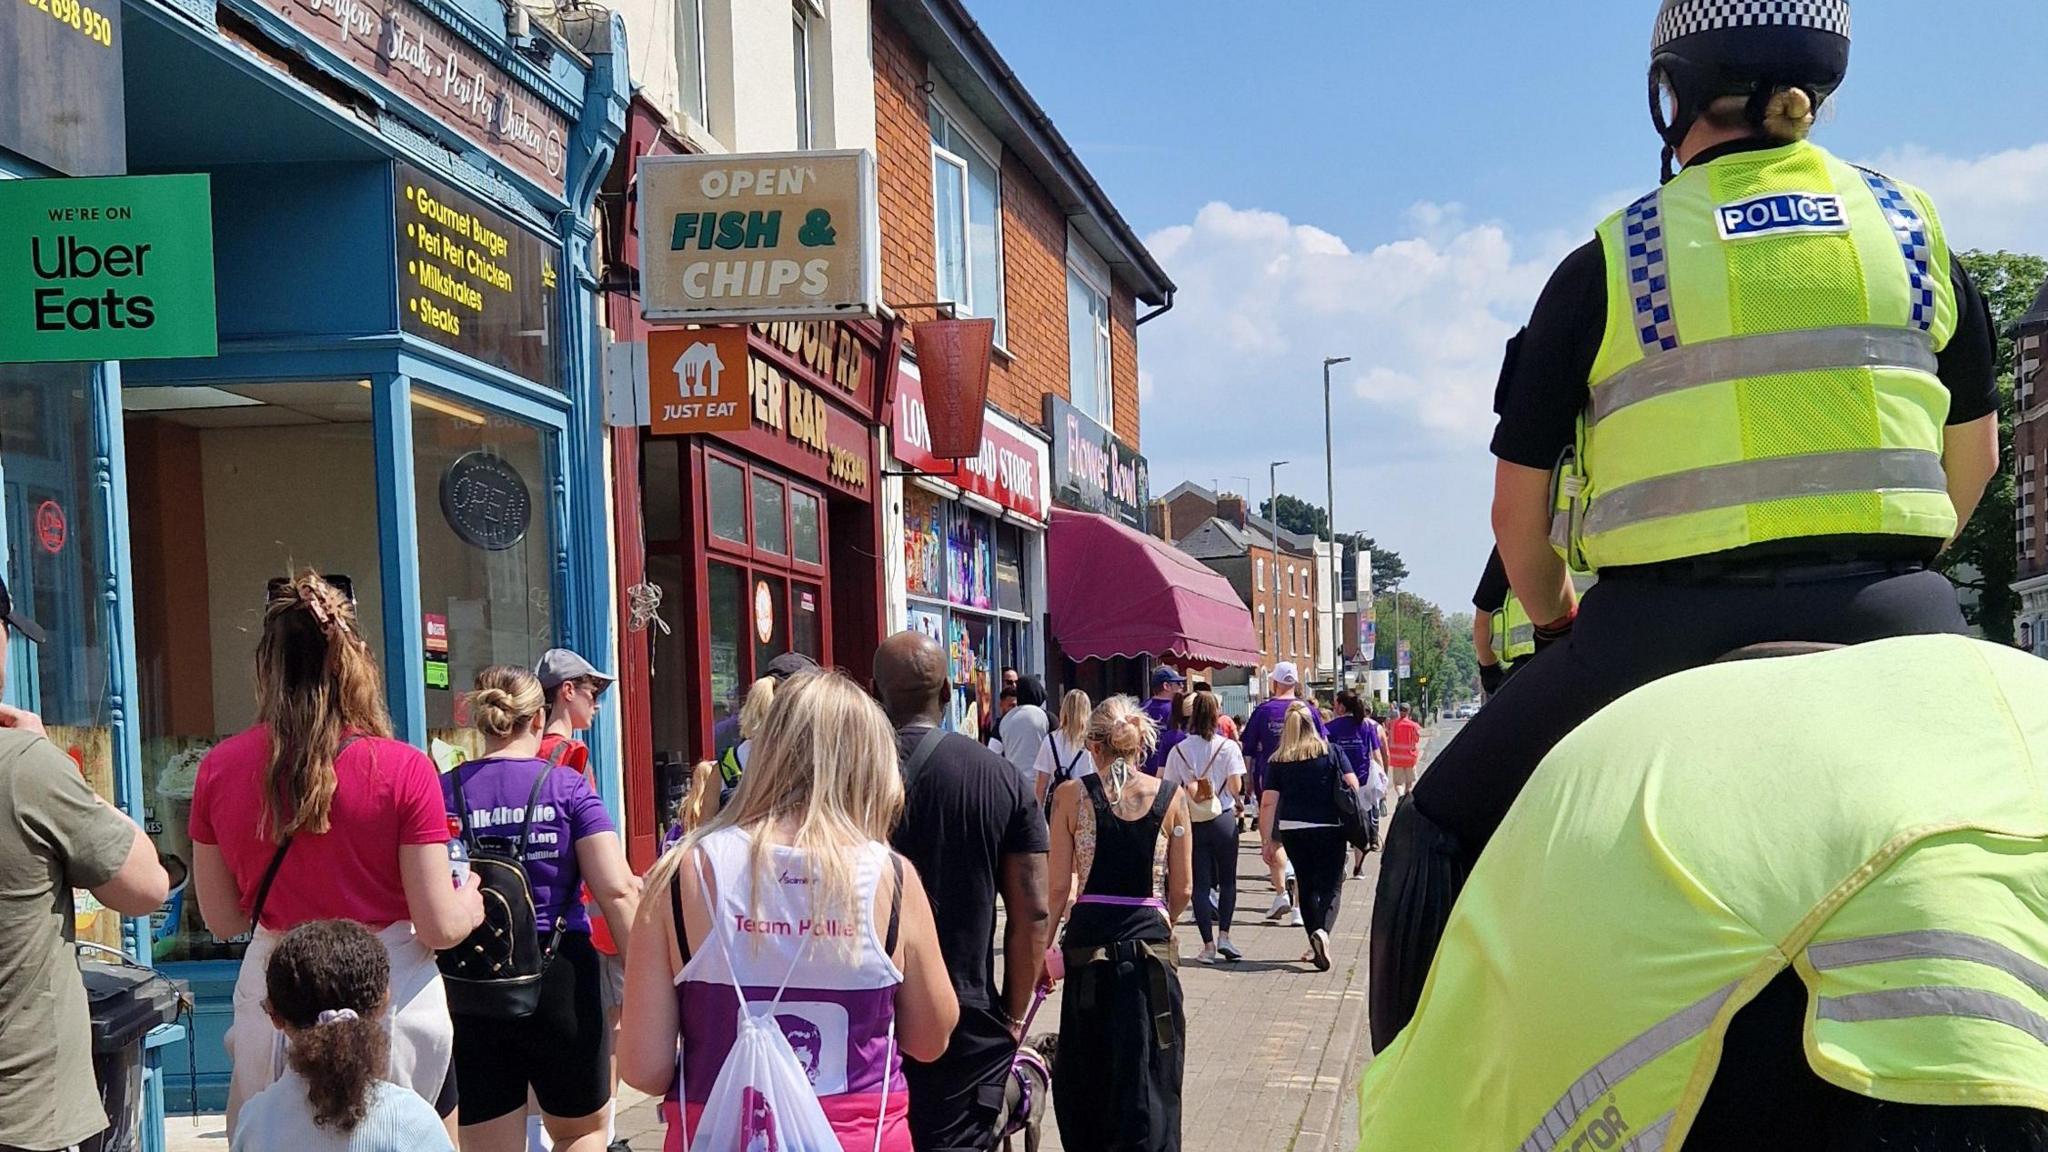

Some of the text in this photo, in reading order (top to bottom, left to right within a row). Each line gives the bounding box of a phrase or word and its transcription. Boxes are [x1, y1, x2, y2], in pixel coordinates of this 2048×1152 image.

[83, 7, 111, 47] 950
[311, 0, 374, 42] rgers
[387, 11, 433, 77] Steaks
[499, 93, 542, 154] Chicken
[701, 166, 805, 199] OPEN
[105, 206, 132, 220] ON
[417, 187, 508, 257] Gourmet Burger
[671, 208, 837, 250] FISH &
[1724, 197, 1841, 230] POLICE
[31, 235, 152, 280] Uber
[417, 223, 441, 257] Peri
[443, 235, 465, 269] Peri
[467, 250, 513, 292] Chicken
[682, 258, 830, 300] CHIPS
[419, 260, 482, 312] Milkshakes
[34, 287, 156, 331] Eats
[420, 296, 461, 336] Steaks
[836, 328, 863, 392] RD
[662, 401, 738, 421] JUST EAT
[788, 378, 828, 453] BAR
[902, 393, 932, 453] LON
[1000, 447, 1035, 500] STORE
[1067, 413, 1137, 509] Flower Bowl
[453, 477, 526, 529] OPEN
[735, 915, 791, 936] Team
